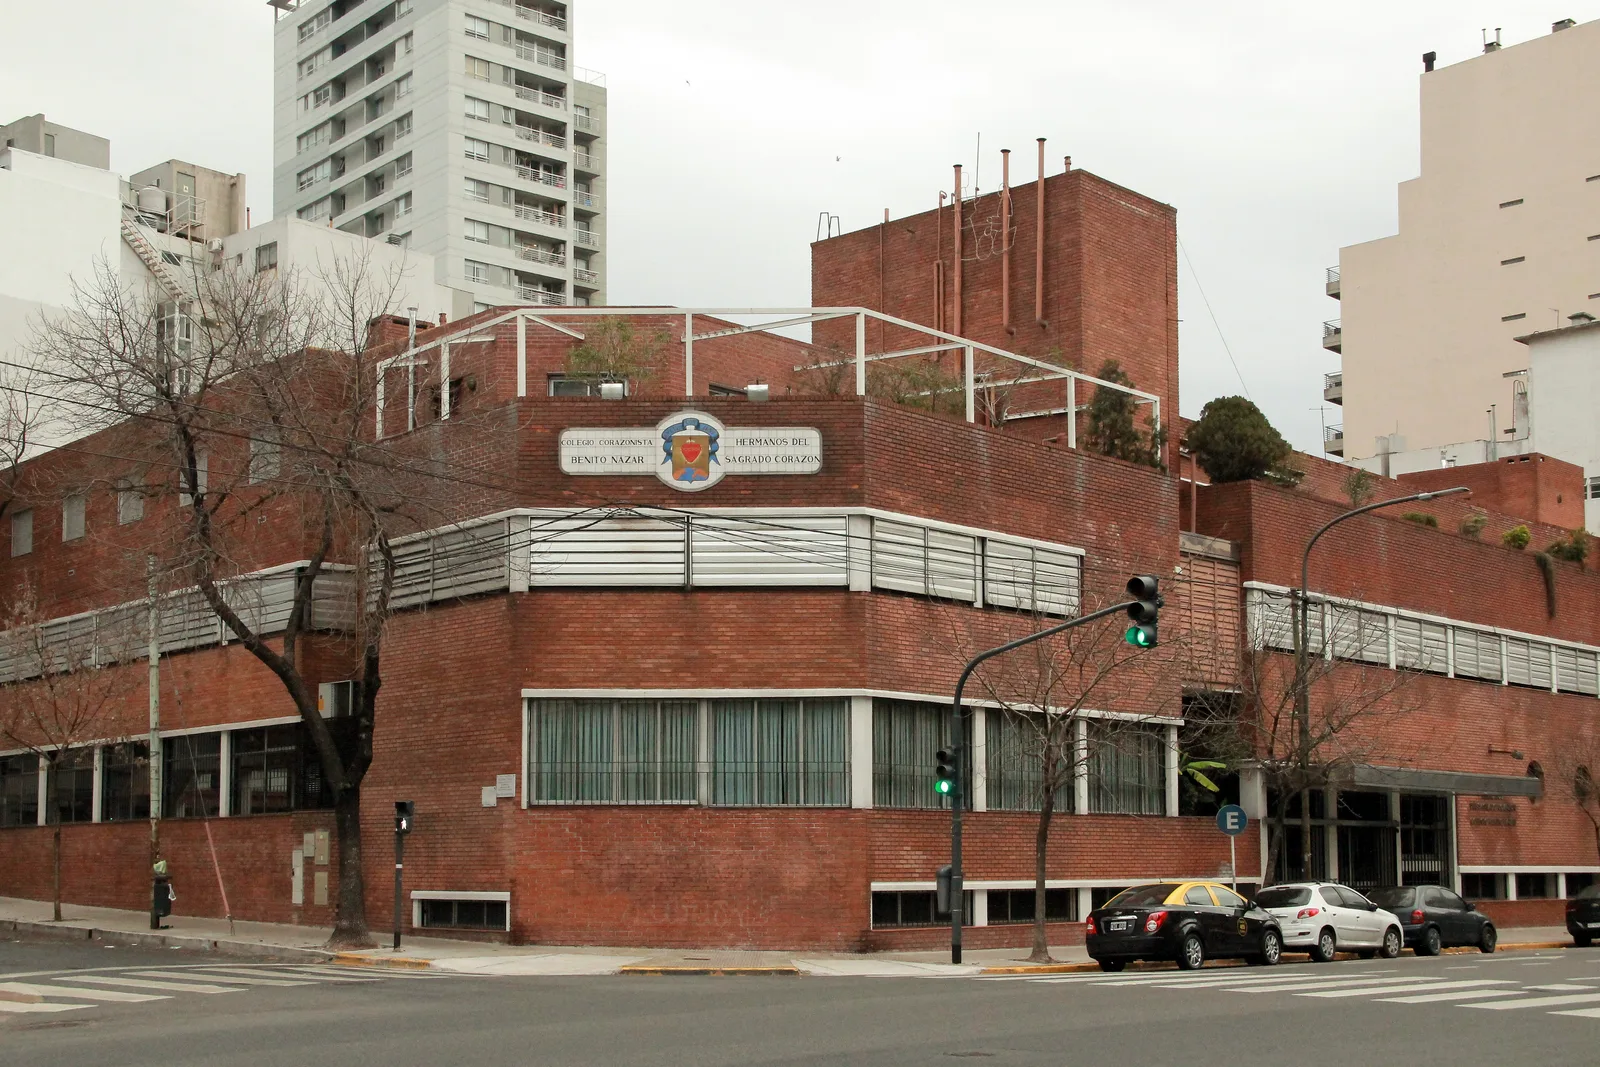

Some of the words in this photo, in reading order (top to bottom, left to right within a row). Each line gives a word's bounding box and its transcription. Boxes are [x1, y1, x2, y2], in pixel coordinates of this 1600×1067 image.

[735, 438, 789, 446] HERMANOS
[791, 438, 810, 446] DEL
[571, 456, 607, 464] BENITO
[611, 456, 645, 464] NAZAR
[724, 455, 772, 463] SAGRADO
[774, 455, 820, 463] CORAZON
[1226, 811, 1239, 830] E
